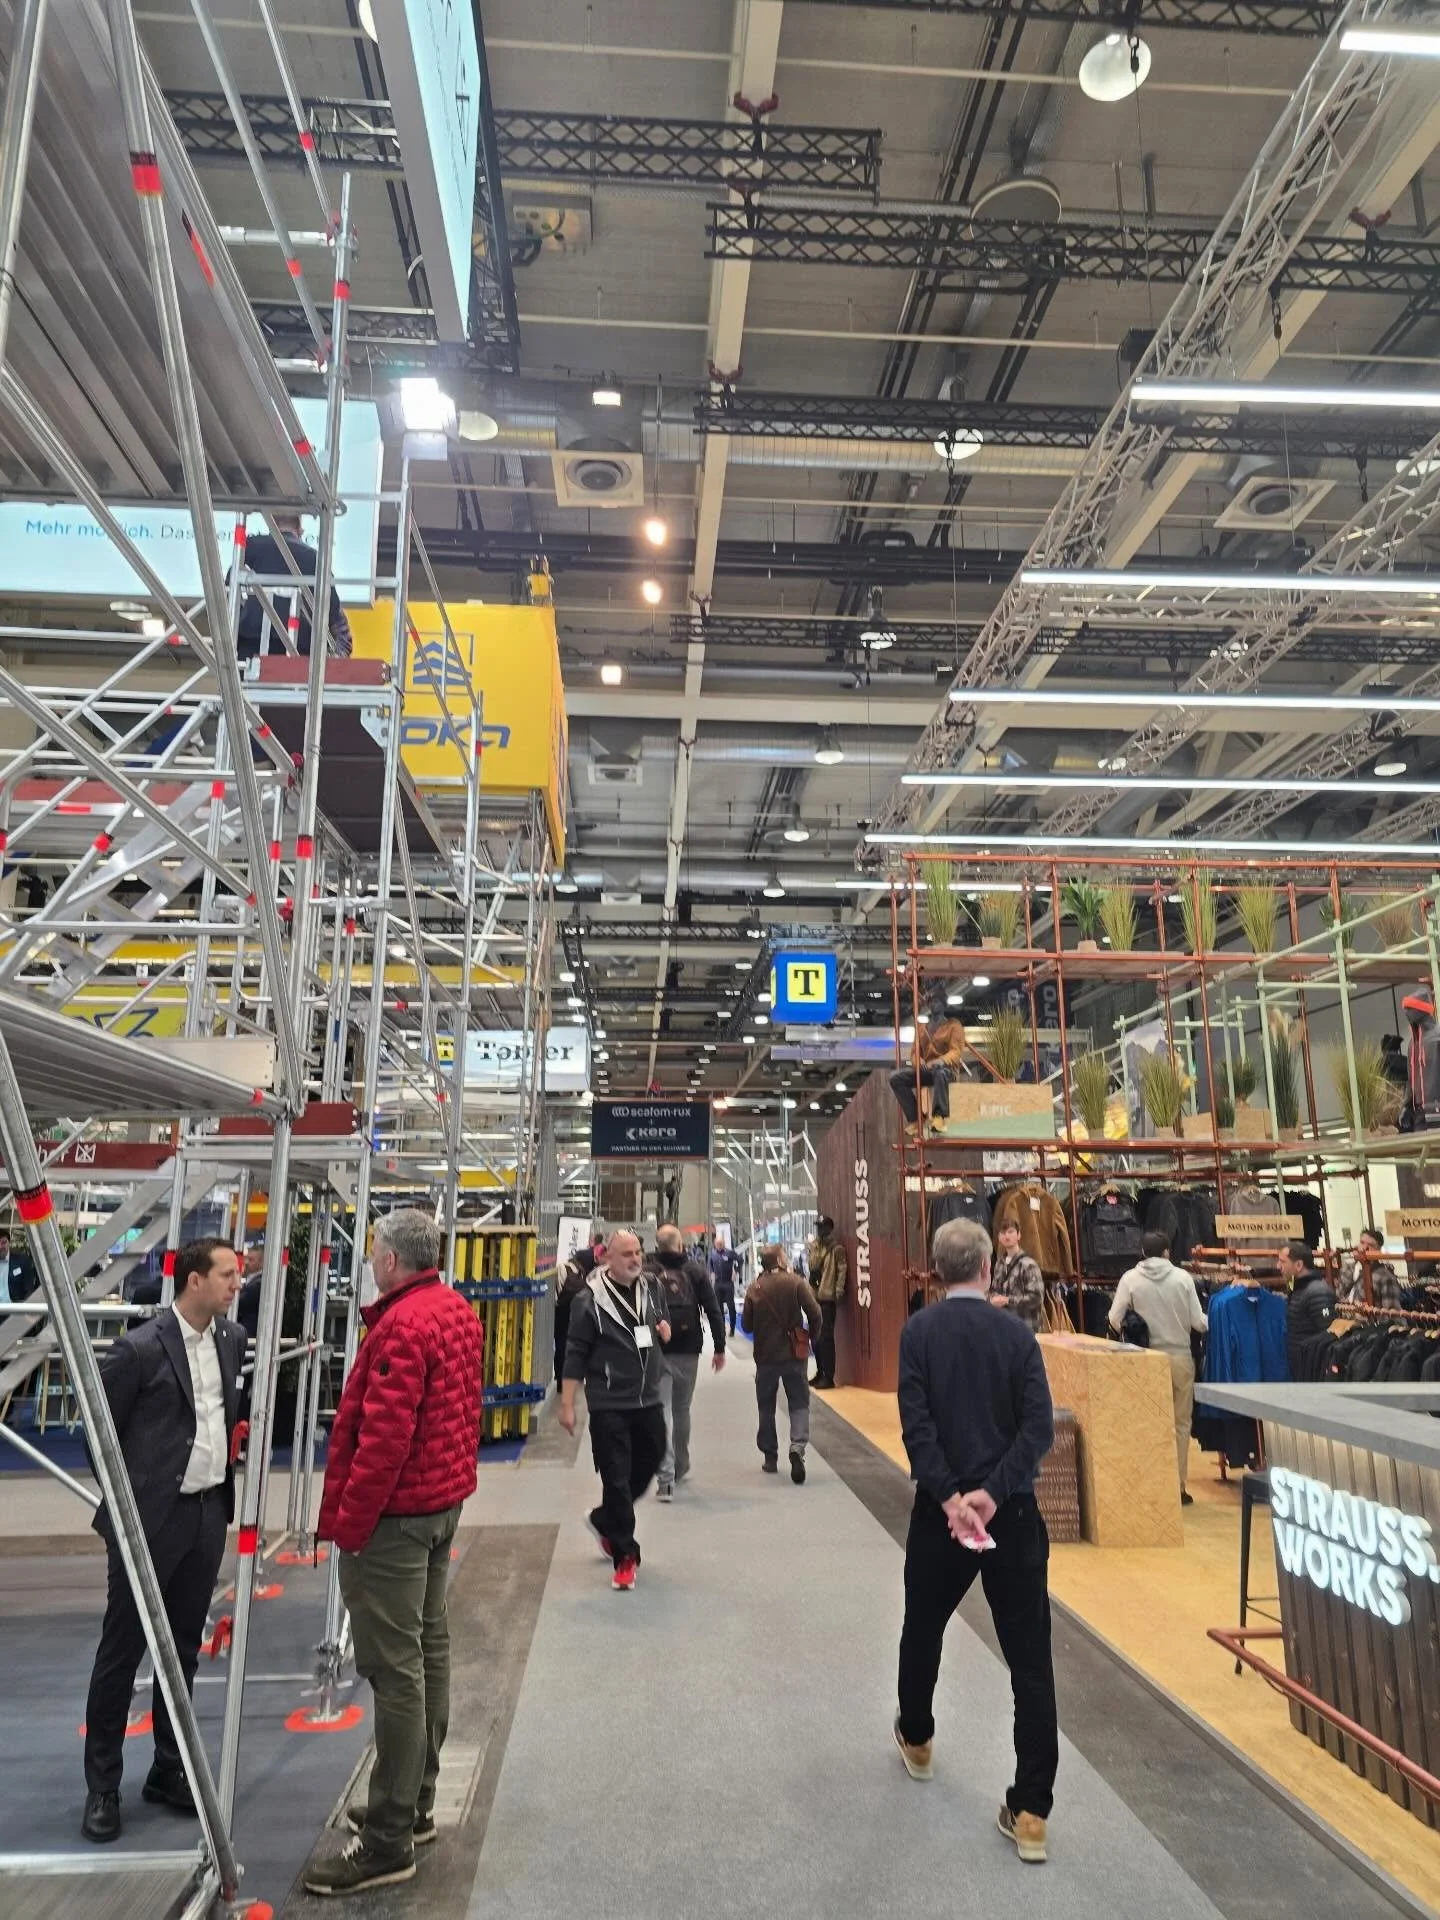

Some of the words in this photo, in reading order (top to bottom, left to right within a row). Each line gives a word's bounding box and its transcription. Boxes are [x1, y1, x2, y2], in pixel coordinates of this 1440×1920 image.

[26, 520, 72, 535] Mehr
[793, 969, 820, 996] T
[477, 1040, 575, 1060] Tober
[854, 1158, 872, 1310] STRAUSS
[1227, 1222, 1264, 1232] MOTION
[1272, 1517, 1411, 1626] WORKS
